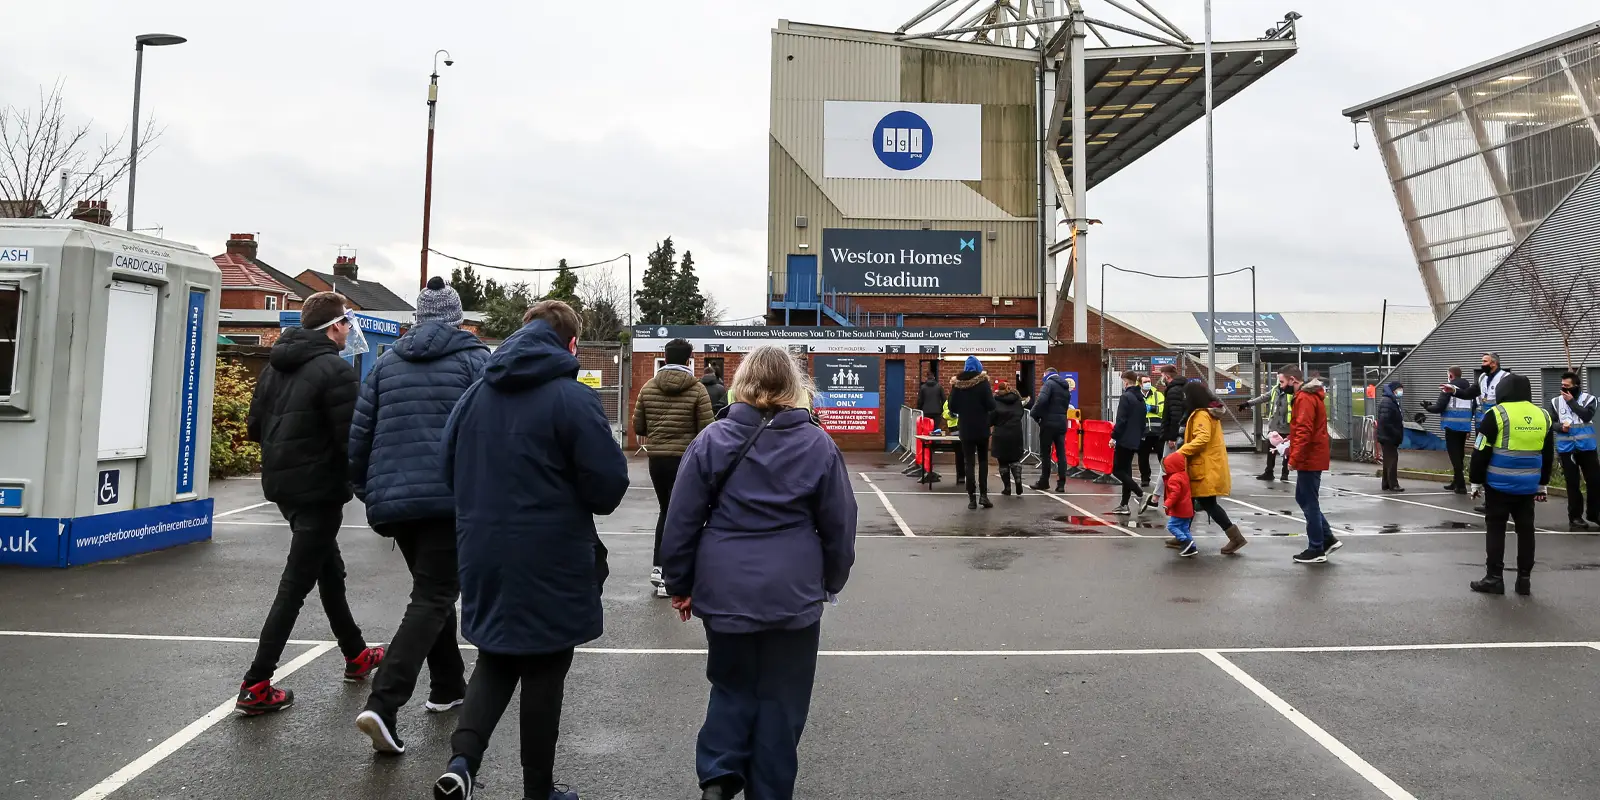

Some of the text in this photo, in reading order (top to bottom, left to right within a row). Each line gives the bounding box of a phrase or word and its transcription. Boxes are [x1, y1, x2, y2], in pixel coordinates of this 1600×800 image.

[886, 136, 918, 151] bgl
[115, 255, 164, 275] CARD/CASH
[830, 248, 962, 265] Weston Homes
[864, 271, 940, 288] Stadium
[373, 320, 397, 333] ENQUIRIES
[836, 330, 851, 338] The
[852, 330, 874, 338] South
[876, 330, 901, 339] Family
[1214, 326, 1272, 334] Homes
[182, 306, 198, 487] PETERBOROUGH RECLINER CENTRE
[76, 514, 209, 548] www.peterboroughreclinercentre.co.uk
